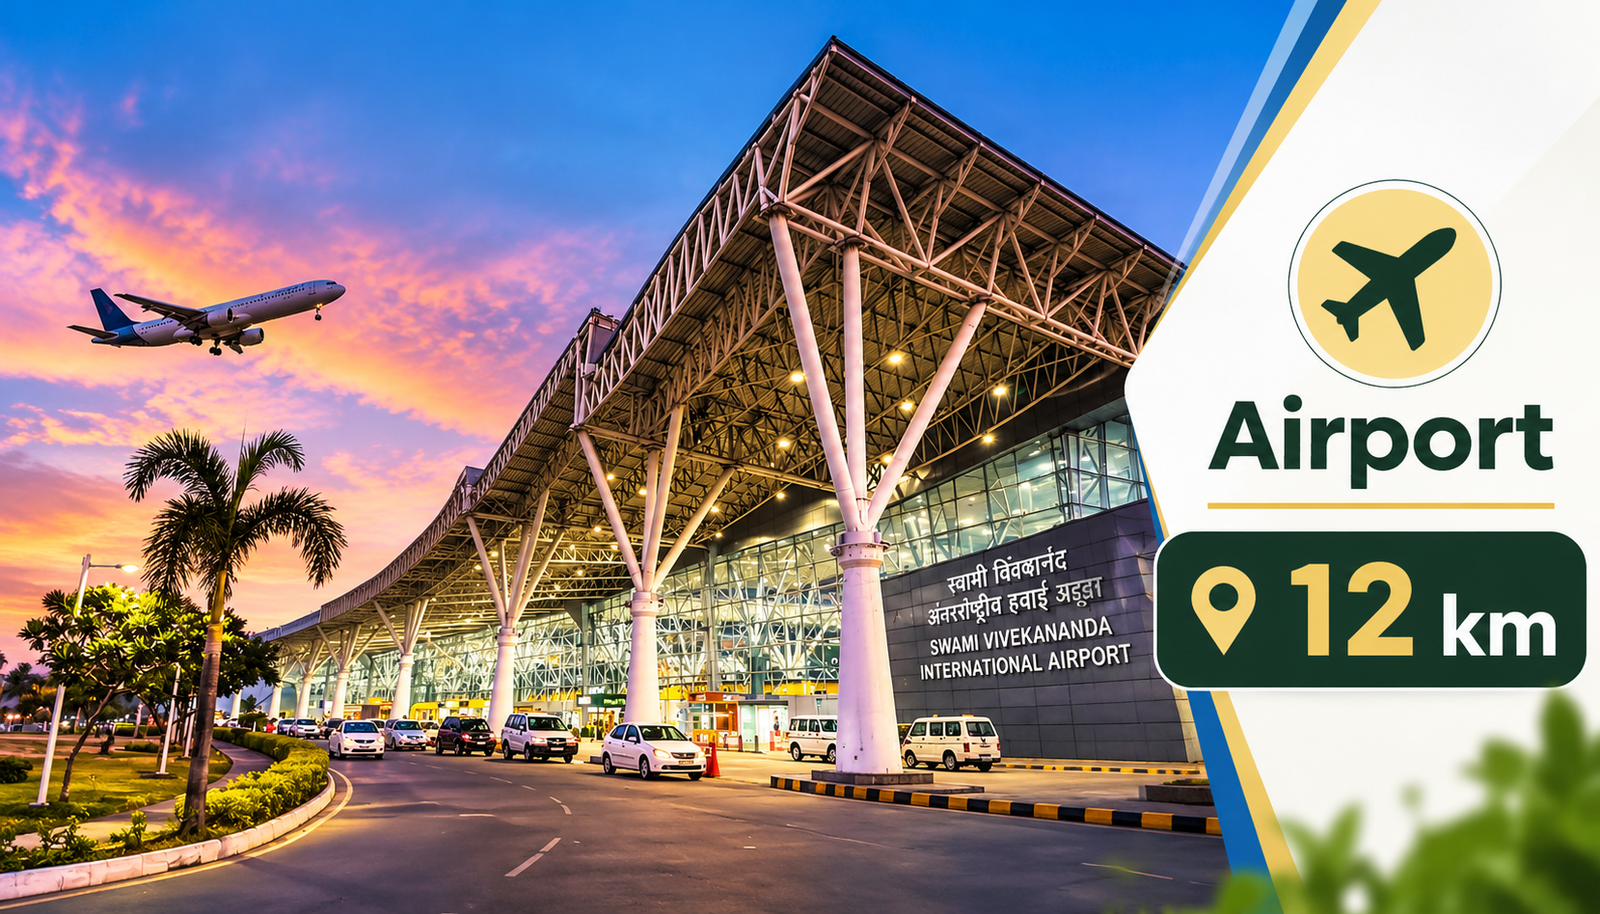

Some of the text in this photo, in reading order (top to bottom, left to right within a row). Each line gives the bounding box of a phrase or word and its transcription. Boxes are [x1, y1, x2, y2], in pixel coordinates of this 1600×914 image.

[946, 563, 988, 594] स्वामी
[1007, 579, 1049, 615] हवाई
[930, 615, 1113, 656] SWAMI VIVEKANANDA
[920, 643, 1131, 681] INTERNATIONAL AIRPORT
